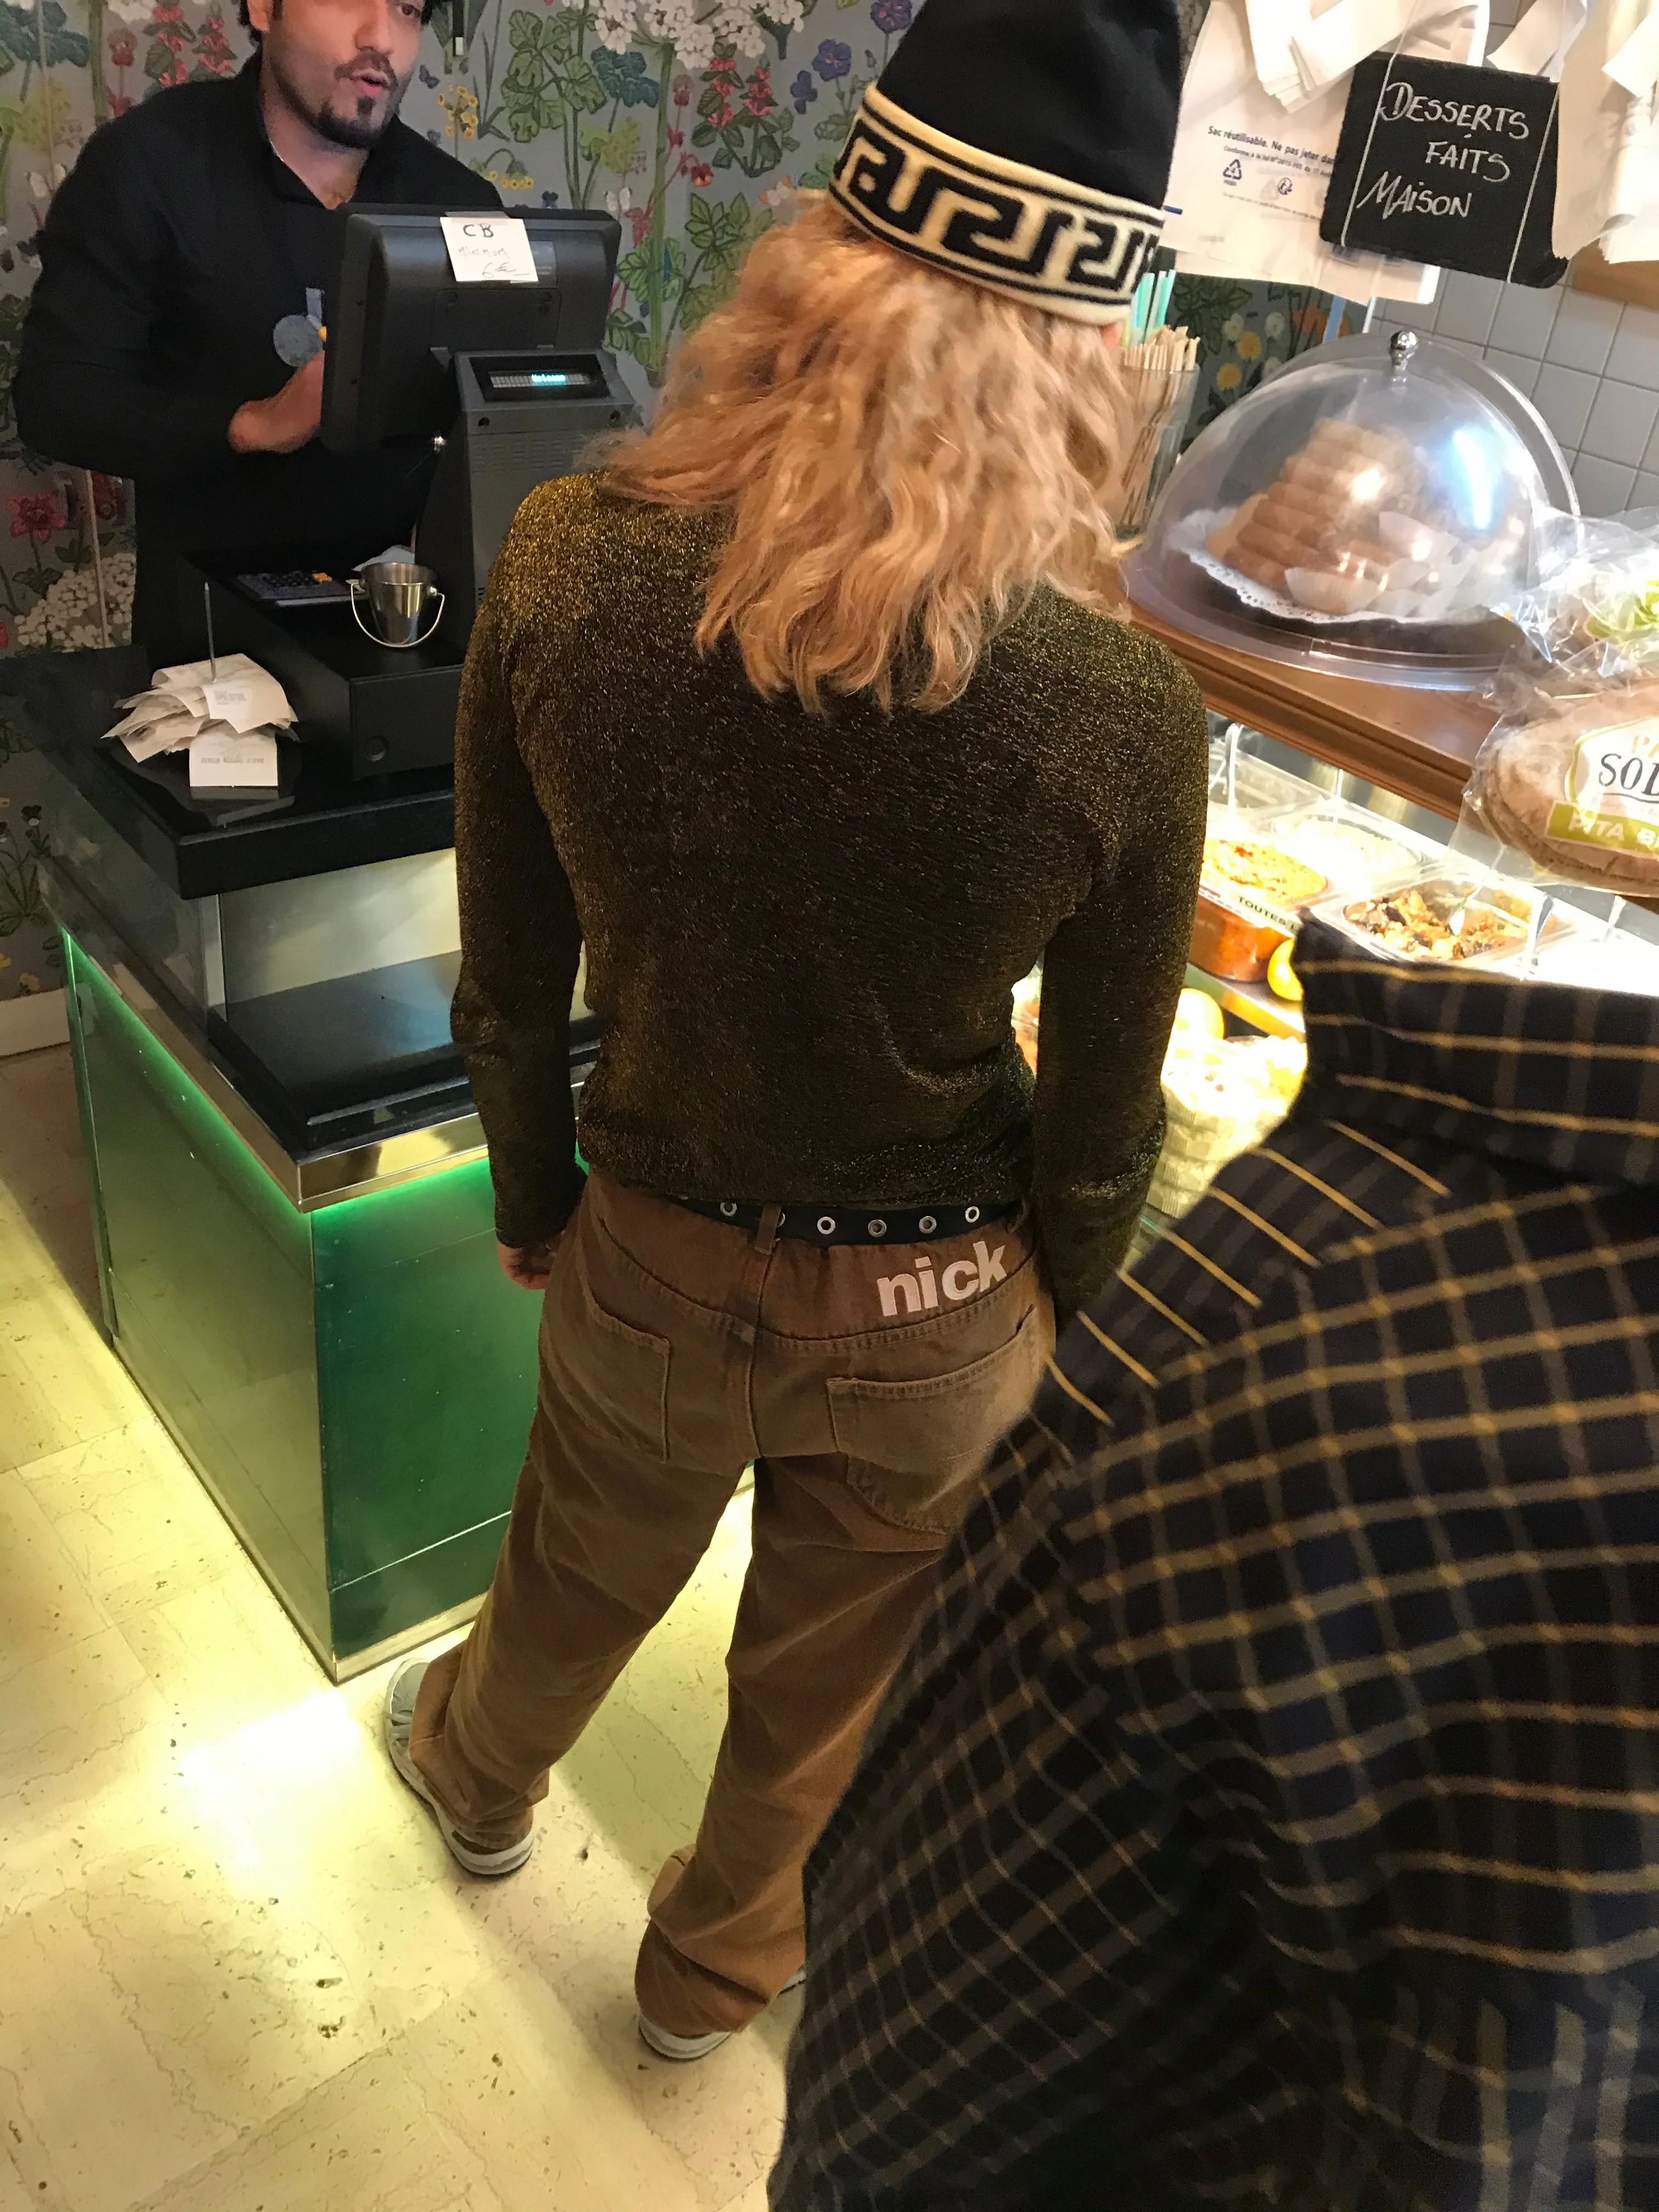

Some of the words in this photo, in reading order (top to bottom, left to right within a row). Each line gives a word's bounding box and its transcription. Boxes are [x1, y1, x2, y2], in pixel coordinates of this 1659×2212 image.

[1379, 82, 1529, 139] DESSERTS
[1208, 125, 1222, 137] Sac
[1271, 140, 1283, 151] Ne
[1284, 146, 1299, 155] pas
[462, 223, 494, 238] CB
[877, 1240, 1007, 1317] nick
